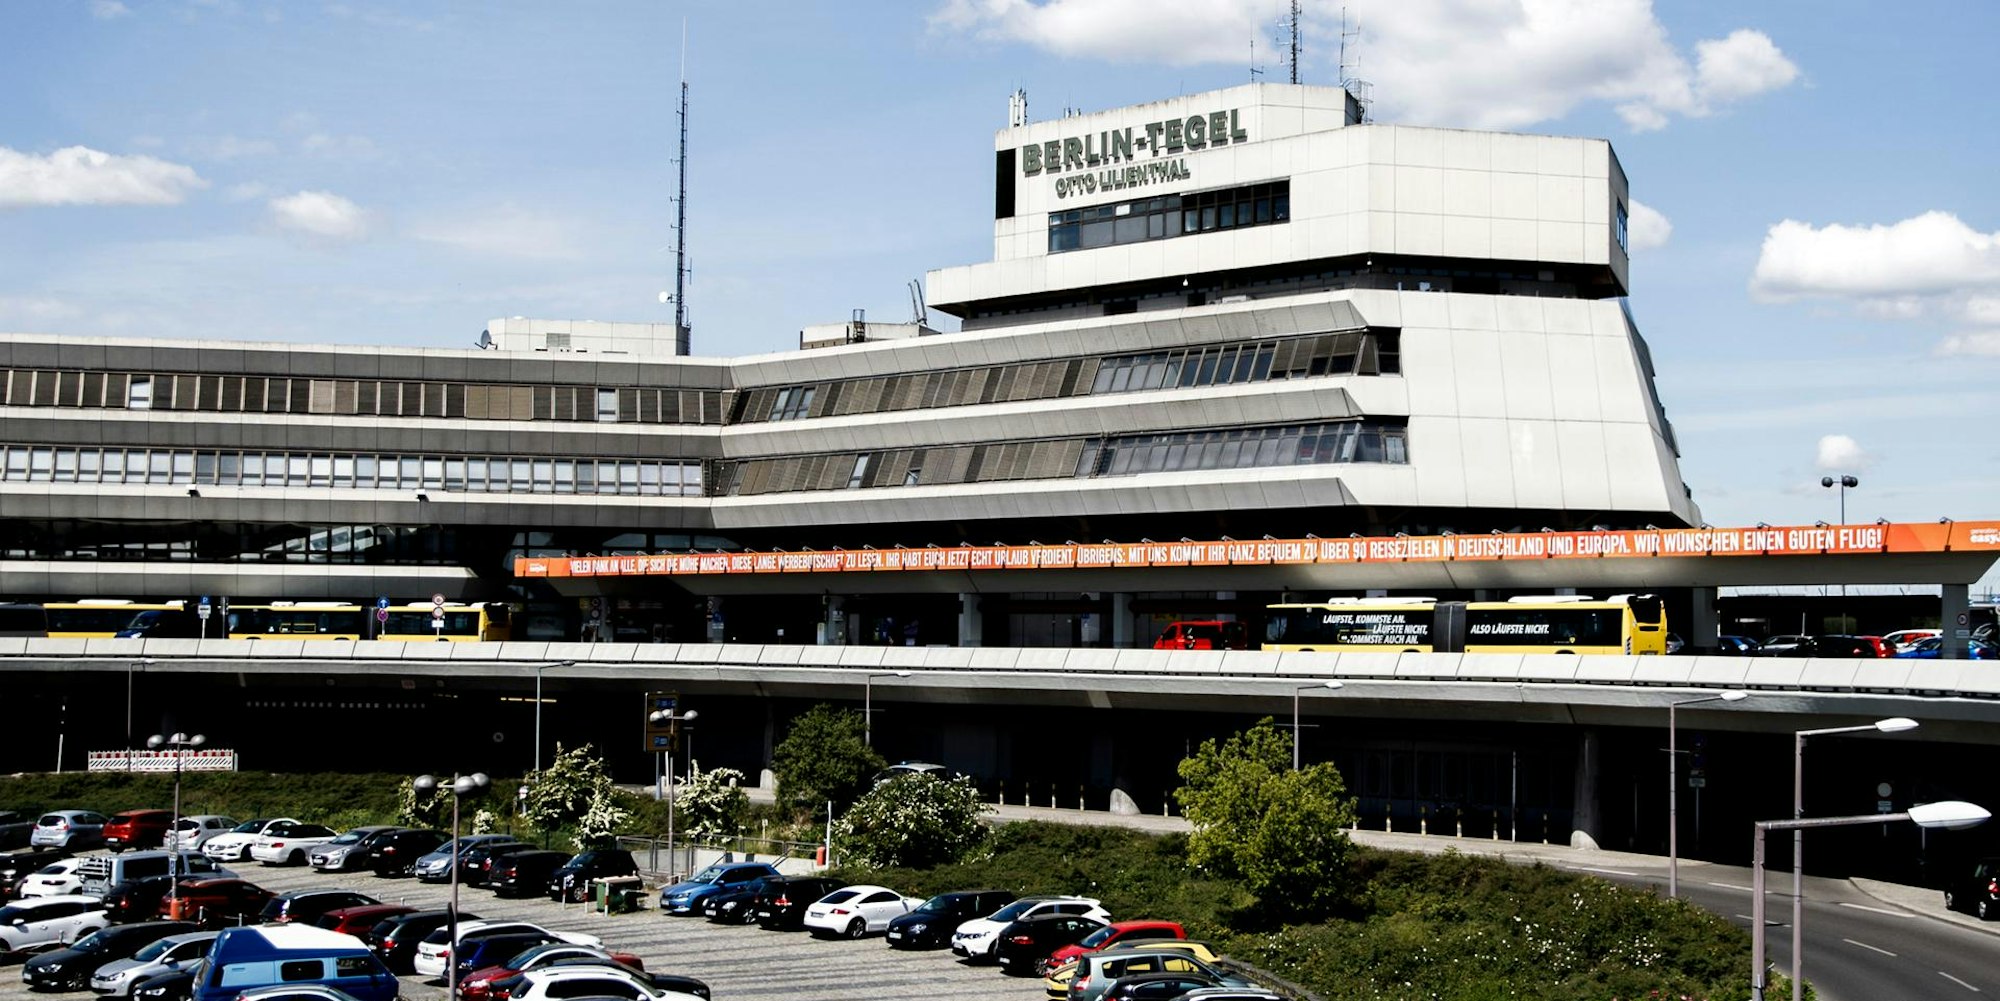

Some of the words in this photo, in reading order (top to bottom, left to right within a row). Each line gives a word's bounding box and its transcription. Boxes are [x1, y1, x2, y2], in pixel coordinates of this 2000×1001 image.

[1022, 108, 1248, 177] BERLIN-TEGEL
[1055, 173, 1097, 198] OTTO
[1100, 158, 1191, 192] LILIENTHAL
[732, 555, 752, 570] DIESE
[754, 555, 777, 569] LANGE
[778, 553, 844, 569] WERBEBOTSCHAFT
[845, 553, 857, 567] ZU
[858, 552, 884, 567] LESEN.
[886, 552, 900, 566] IHR
[902, 551, 921, 566] HABT
[924, 551, 945, 566] EUCH
[948, 551, 970, 565] JETZT
[971, 550, 992, 565] ECHT
[994, 549, 1028, 565] URLAUB
[1129, 547, 1148, 562] MIT
[1150, 546, 1167, 562] UNS
[1170, 545, 1205, 561] KOMMT
[1208, 545, 1225, 561] IHR
[1228, 543, 1254, 560] GANZ
[1258, 543, 1300, 560] BEQUEM
[1304, 543, 1318, 560] ZU
[1353, 541, 1366, 559] 90
[1371, 539, 1439, 559] REISEZIELEN
[1443, 539, 1455, 557] IN
[1458, 537, 1544, 557] DEUTSCHLAND
[1548, 536, 1573, 554] UND
[1577, 534, 1631, 555] EUROPA.
[1634, 534, 1660, 553] WIR
[1664, 530, 1739, 553] WÜNSCHEN
[1744, 531, 1784, 551] EINEN
[1789, 529, 1835, 550] GUTEN
[1840, 528, 1882, 549] FLUG!
[1355, 614, 1392, 624] KOMMSTE
[1392, 614, 1406, 624] AN.
[1404, 624, 1428, 635] NICHT,
[1470, 624, 1491, 634] ALSO
[1524, 624, 1550, 634] NICHT.
[1384, 634, 1404, 644] AUCH
[1405, 634, 1419, 644] AN.
